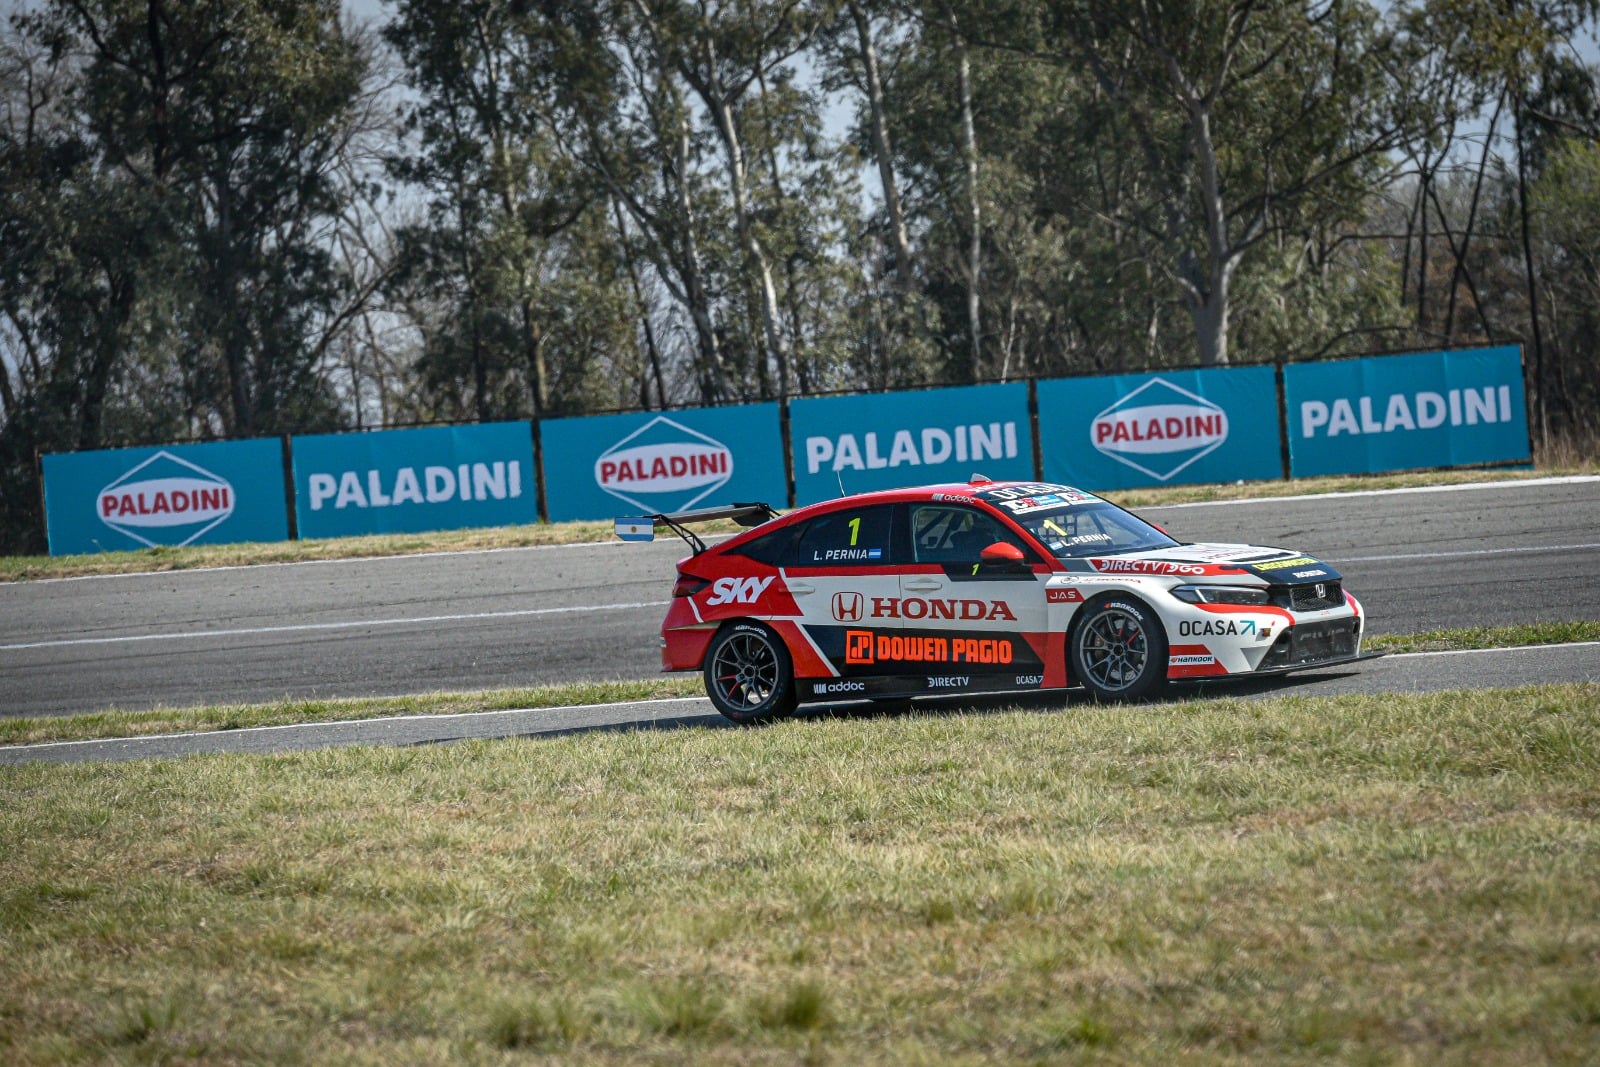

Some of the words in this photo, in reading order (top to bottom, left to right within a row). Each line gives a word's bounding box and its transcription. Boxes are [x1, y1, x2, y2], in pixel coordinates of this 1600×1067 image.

[1301, 386, 1511, 438] PALADINI
[1096, 414, 1222, 444] PALADINI
[806, 421, 1017, 475] PALADINI
[600, 452, 728, 484] PALADINI
[309, 460, 521, 510] PALADINI
[102, 488, 229, 517] PALADINI
[944, 494, 976, 504] addoc
[848, 517, 861, 546] 1
[1043, 519, 1068, 536] 1
[1072, 533, 1112, 545] PERNIA
[813, 551, 823, 561] L.
[825, 549, 868, 560] PERNIA
[971, 563, 980, 576] 1
[1100, 559, 1161, 572] DIRECTV
[706, 575, 776, 606] SKY
[1050, 591, 1076, 599] JAS
[870, 598, 1017, 621] HONDA
[1179, 619, 1238, 637] OCASA
[877, 636, 947, 661] DOWEN
[952, 638, 1013, 664] PAGIO
[827, 681, 865, 692] addoc
[927, 676, 969, 688] DIRECTV
[1016, 676, 1038, 685] OCASA
